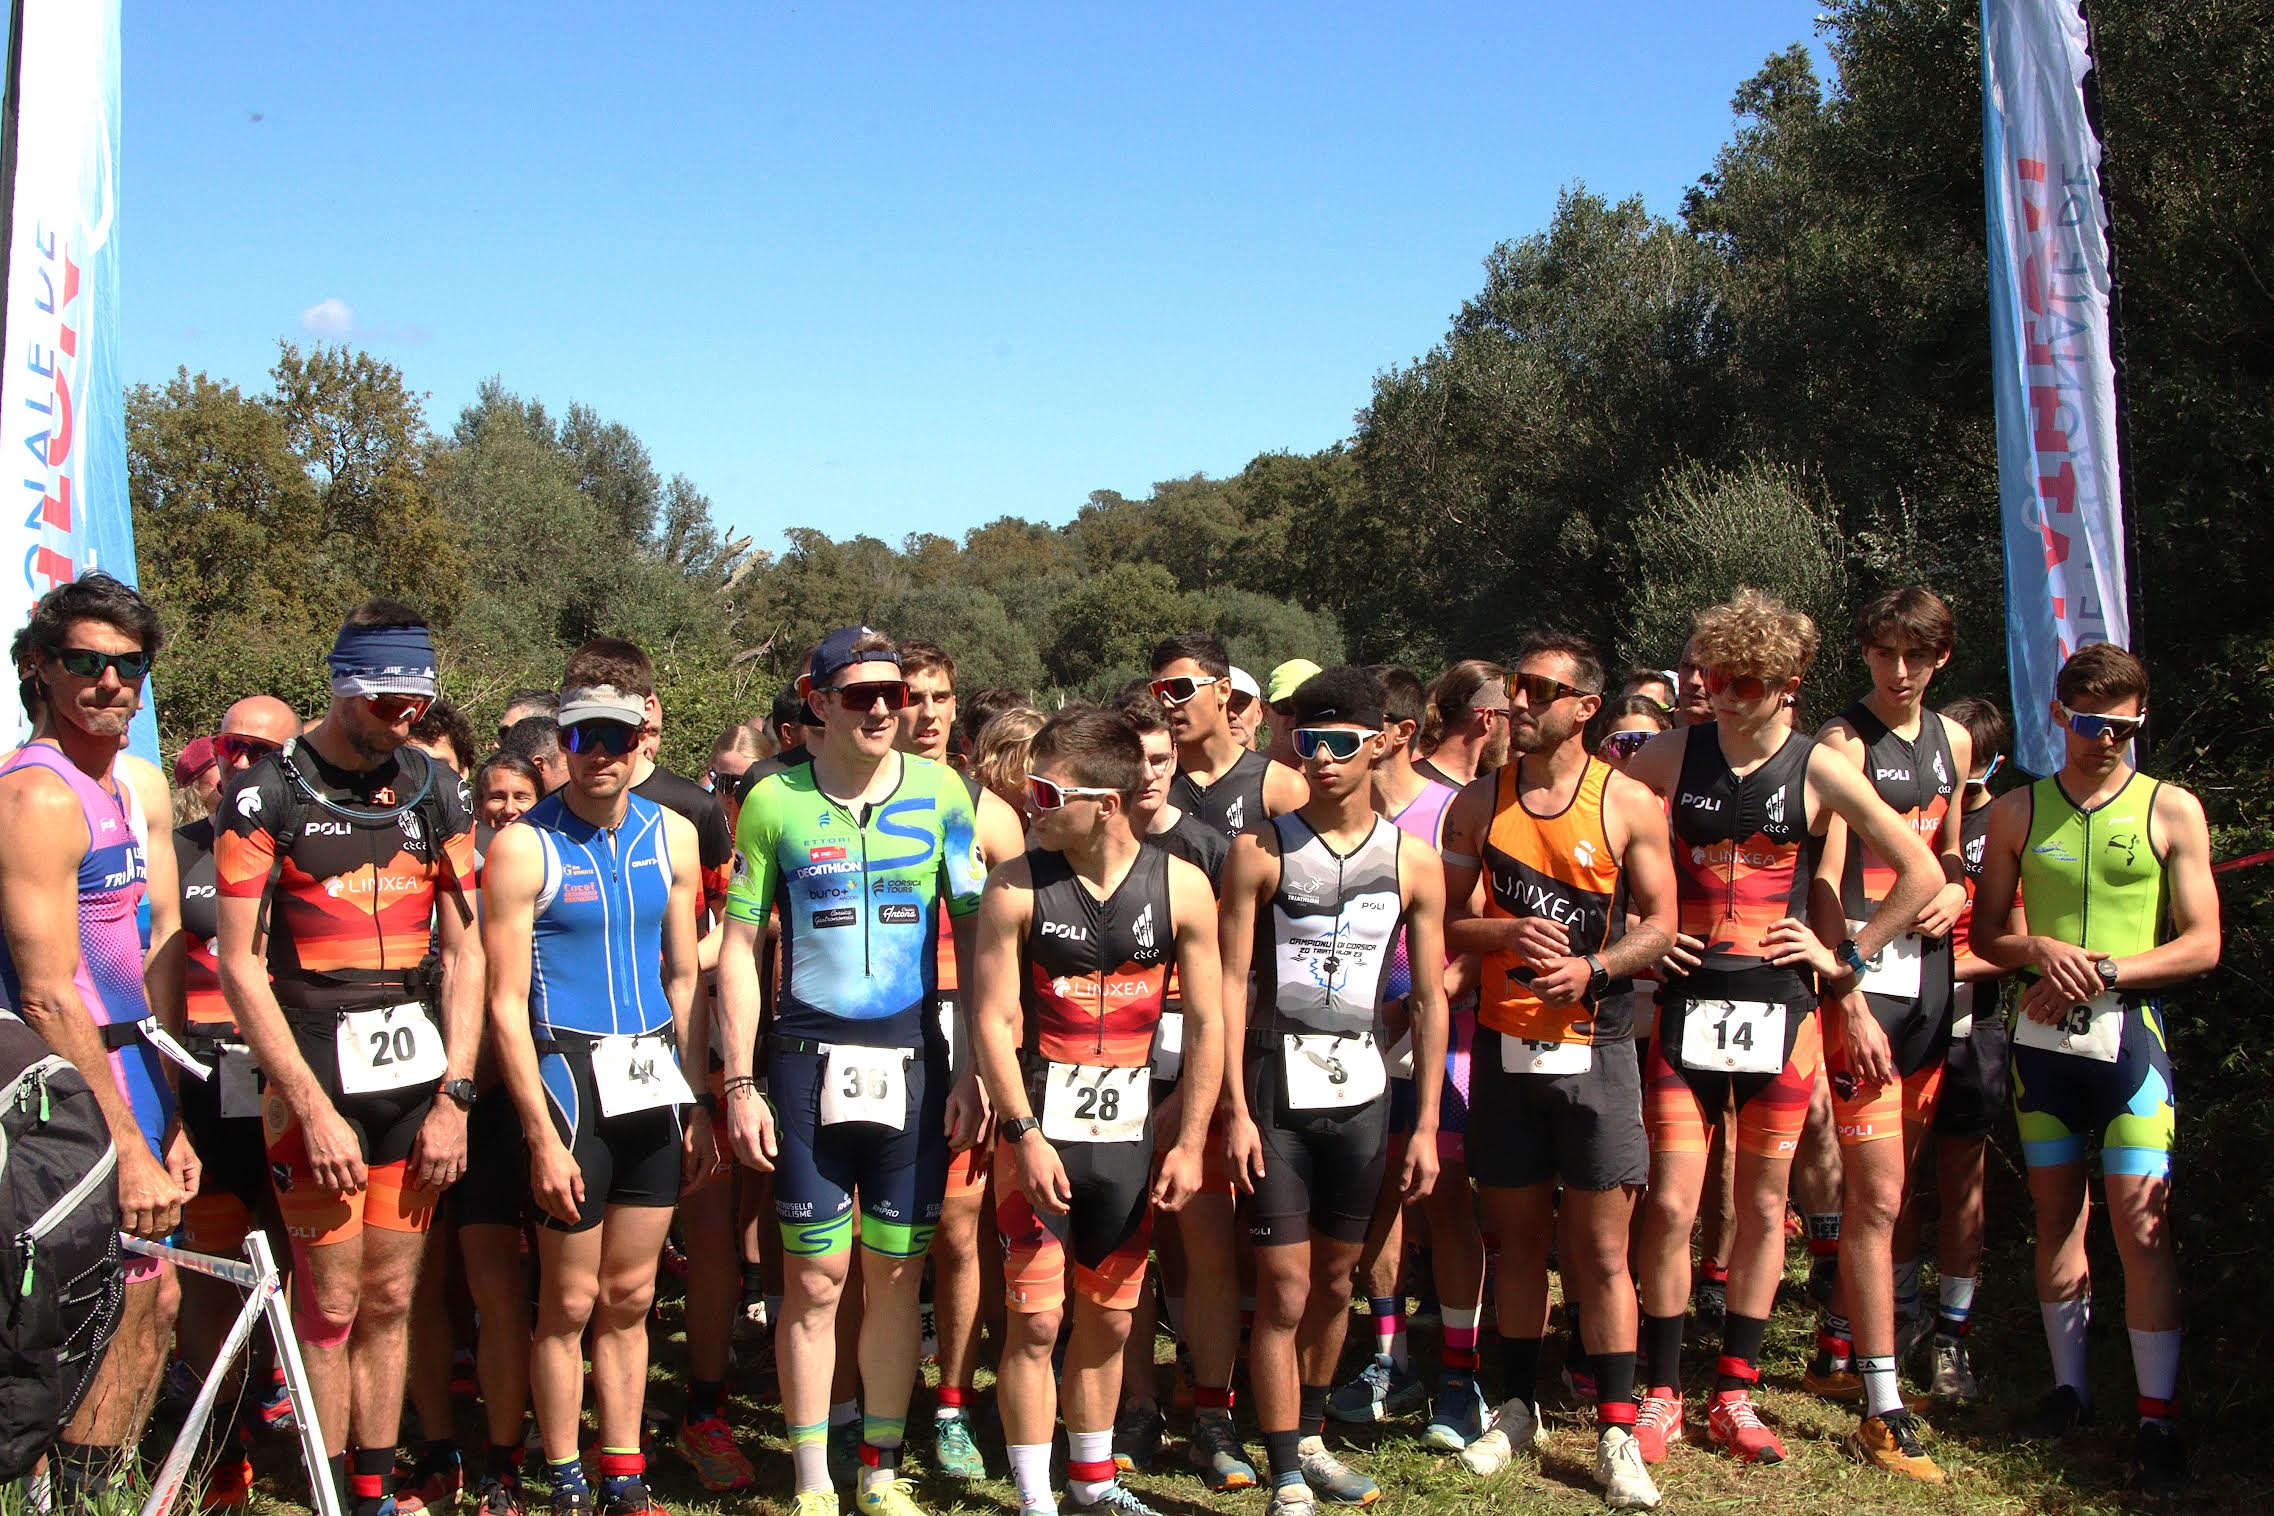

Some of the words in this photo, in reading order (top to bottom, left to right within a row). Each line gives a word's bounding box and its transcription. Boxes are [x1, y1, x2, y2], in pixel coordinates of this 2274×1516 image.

[1876, 769, 1910, 781] POLI
[1680, 793, 1722, 812] POLI
[304, 822, 353, 837] POLI
[803, 837, 851, 847] ETTORI
[1708, 850, 1778, 866] LINXEA
[796, 860, 862, 879] DECATHLON
[347, 875, 418, 893] LINXEA
[887, 879, 922, 888] CORSICA
[887, 886, 913, 894] TOURS
[185, 885, 217, 900] PO
[1287, 894, 1320, 905] TRIATHLON
[1361, 902, 1385, 910] POLI
[1492, 871, 1586, 933] LINXEA
[1041, 921, 1087, 941] POLI
[1074, 980, 1149, 997] LINXEA
[1713, 1020, 1754, 1051] 14
[370, 1026, 416, 1067] 20
[843, 1066, 888, 1100] 36
[1073, 1086, 1120, 1121] 28
[286, 1225, 317, 1238] OLI
[1249, 1227, 1271, 1236] POLI
